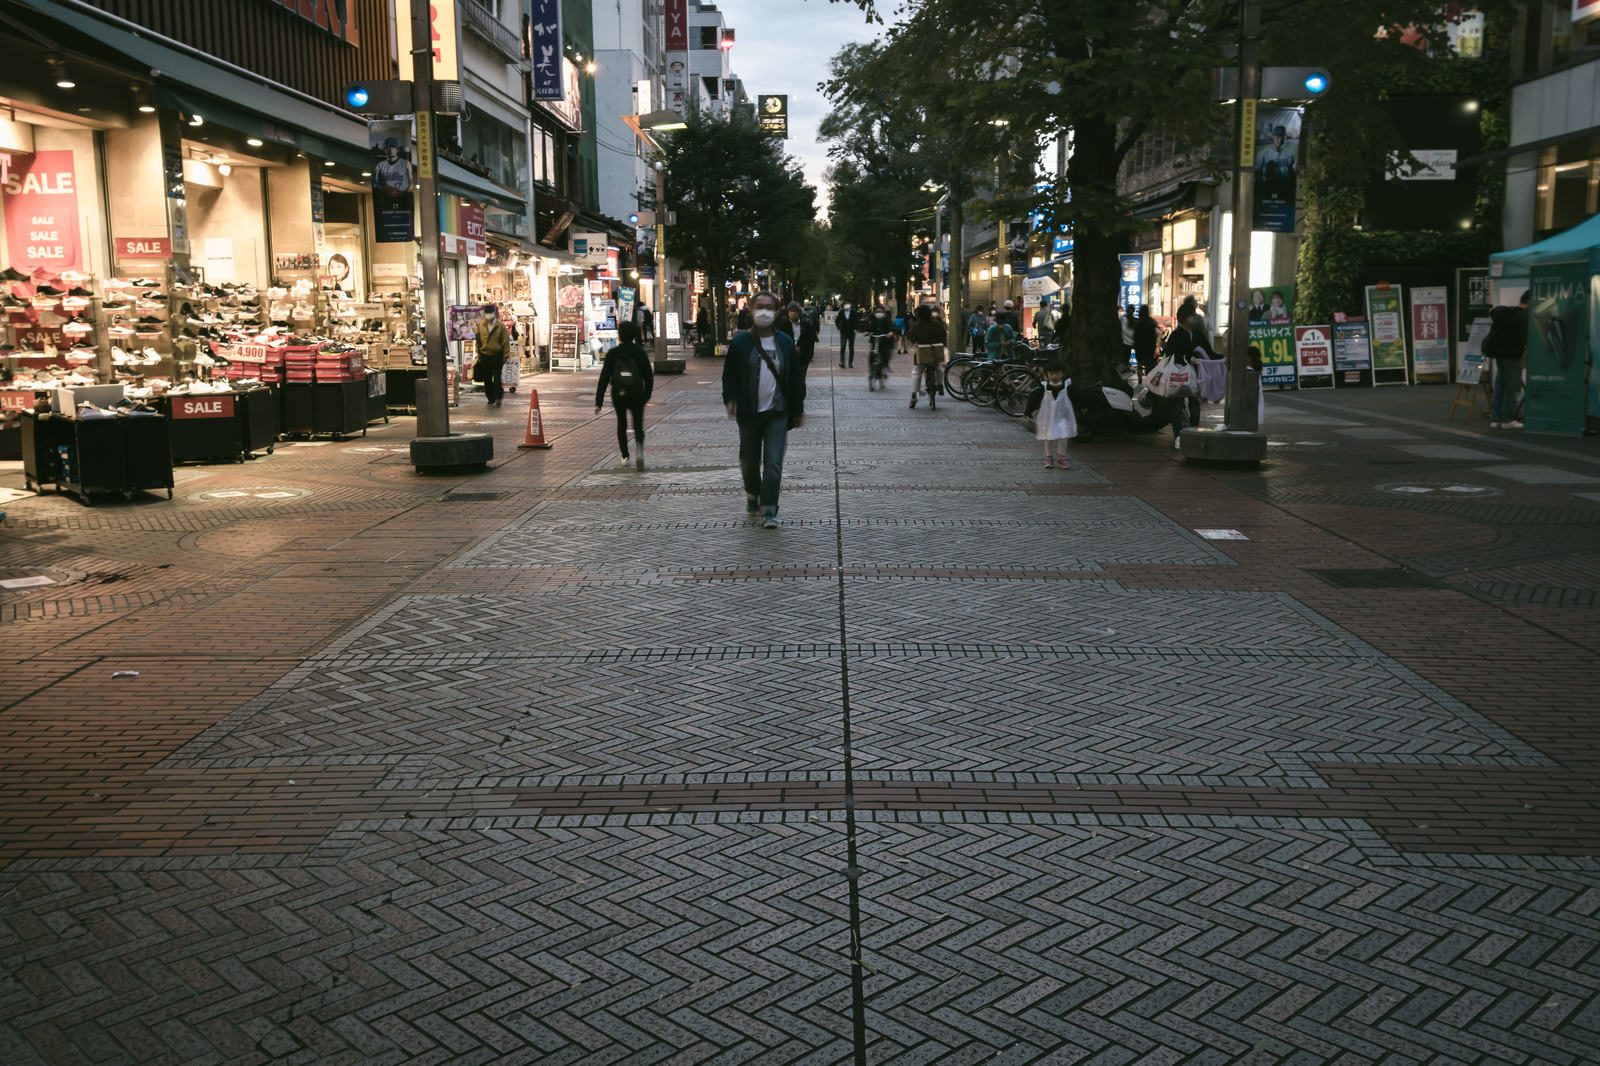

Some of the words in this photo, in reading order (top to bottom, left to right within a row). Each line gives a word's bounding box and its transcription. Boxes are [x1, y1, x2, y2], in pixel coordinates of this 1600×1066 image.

[5, 173, 73, 194] SALE
[32, 216, 55, 225] SALE
[30, 231, 59, 241] SALE
[27, 246, 64, 258] SALE
[126, 242, 161, 254] SALE
[1532, 282, 1586, 302] ILUMA
[1420, 304, 1440, 339] 歯科
[26, 331, 61, 344] SALE
[1249, 327, 1292, 339] 大きいサイズ
[237, 346, 264, 358] 4,900
[1266, 367, 1278, 375] 3F
[184, 401, 223, 414] SALE
